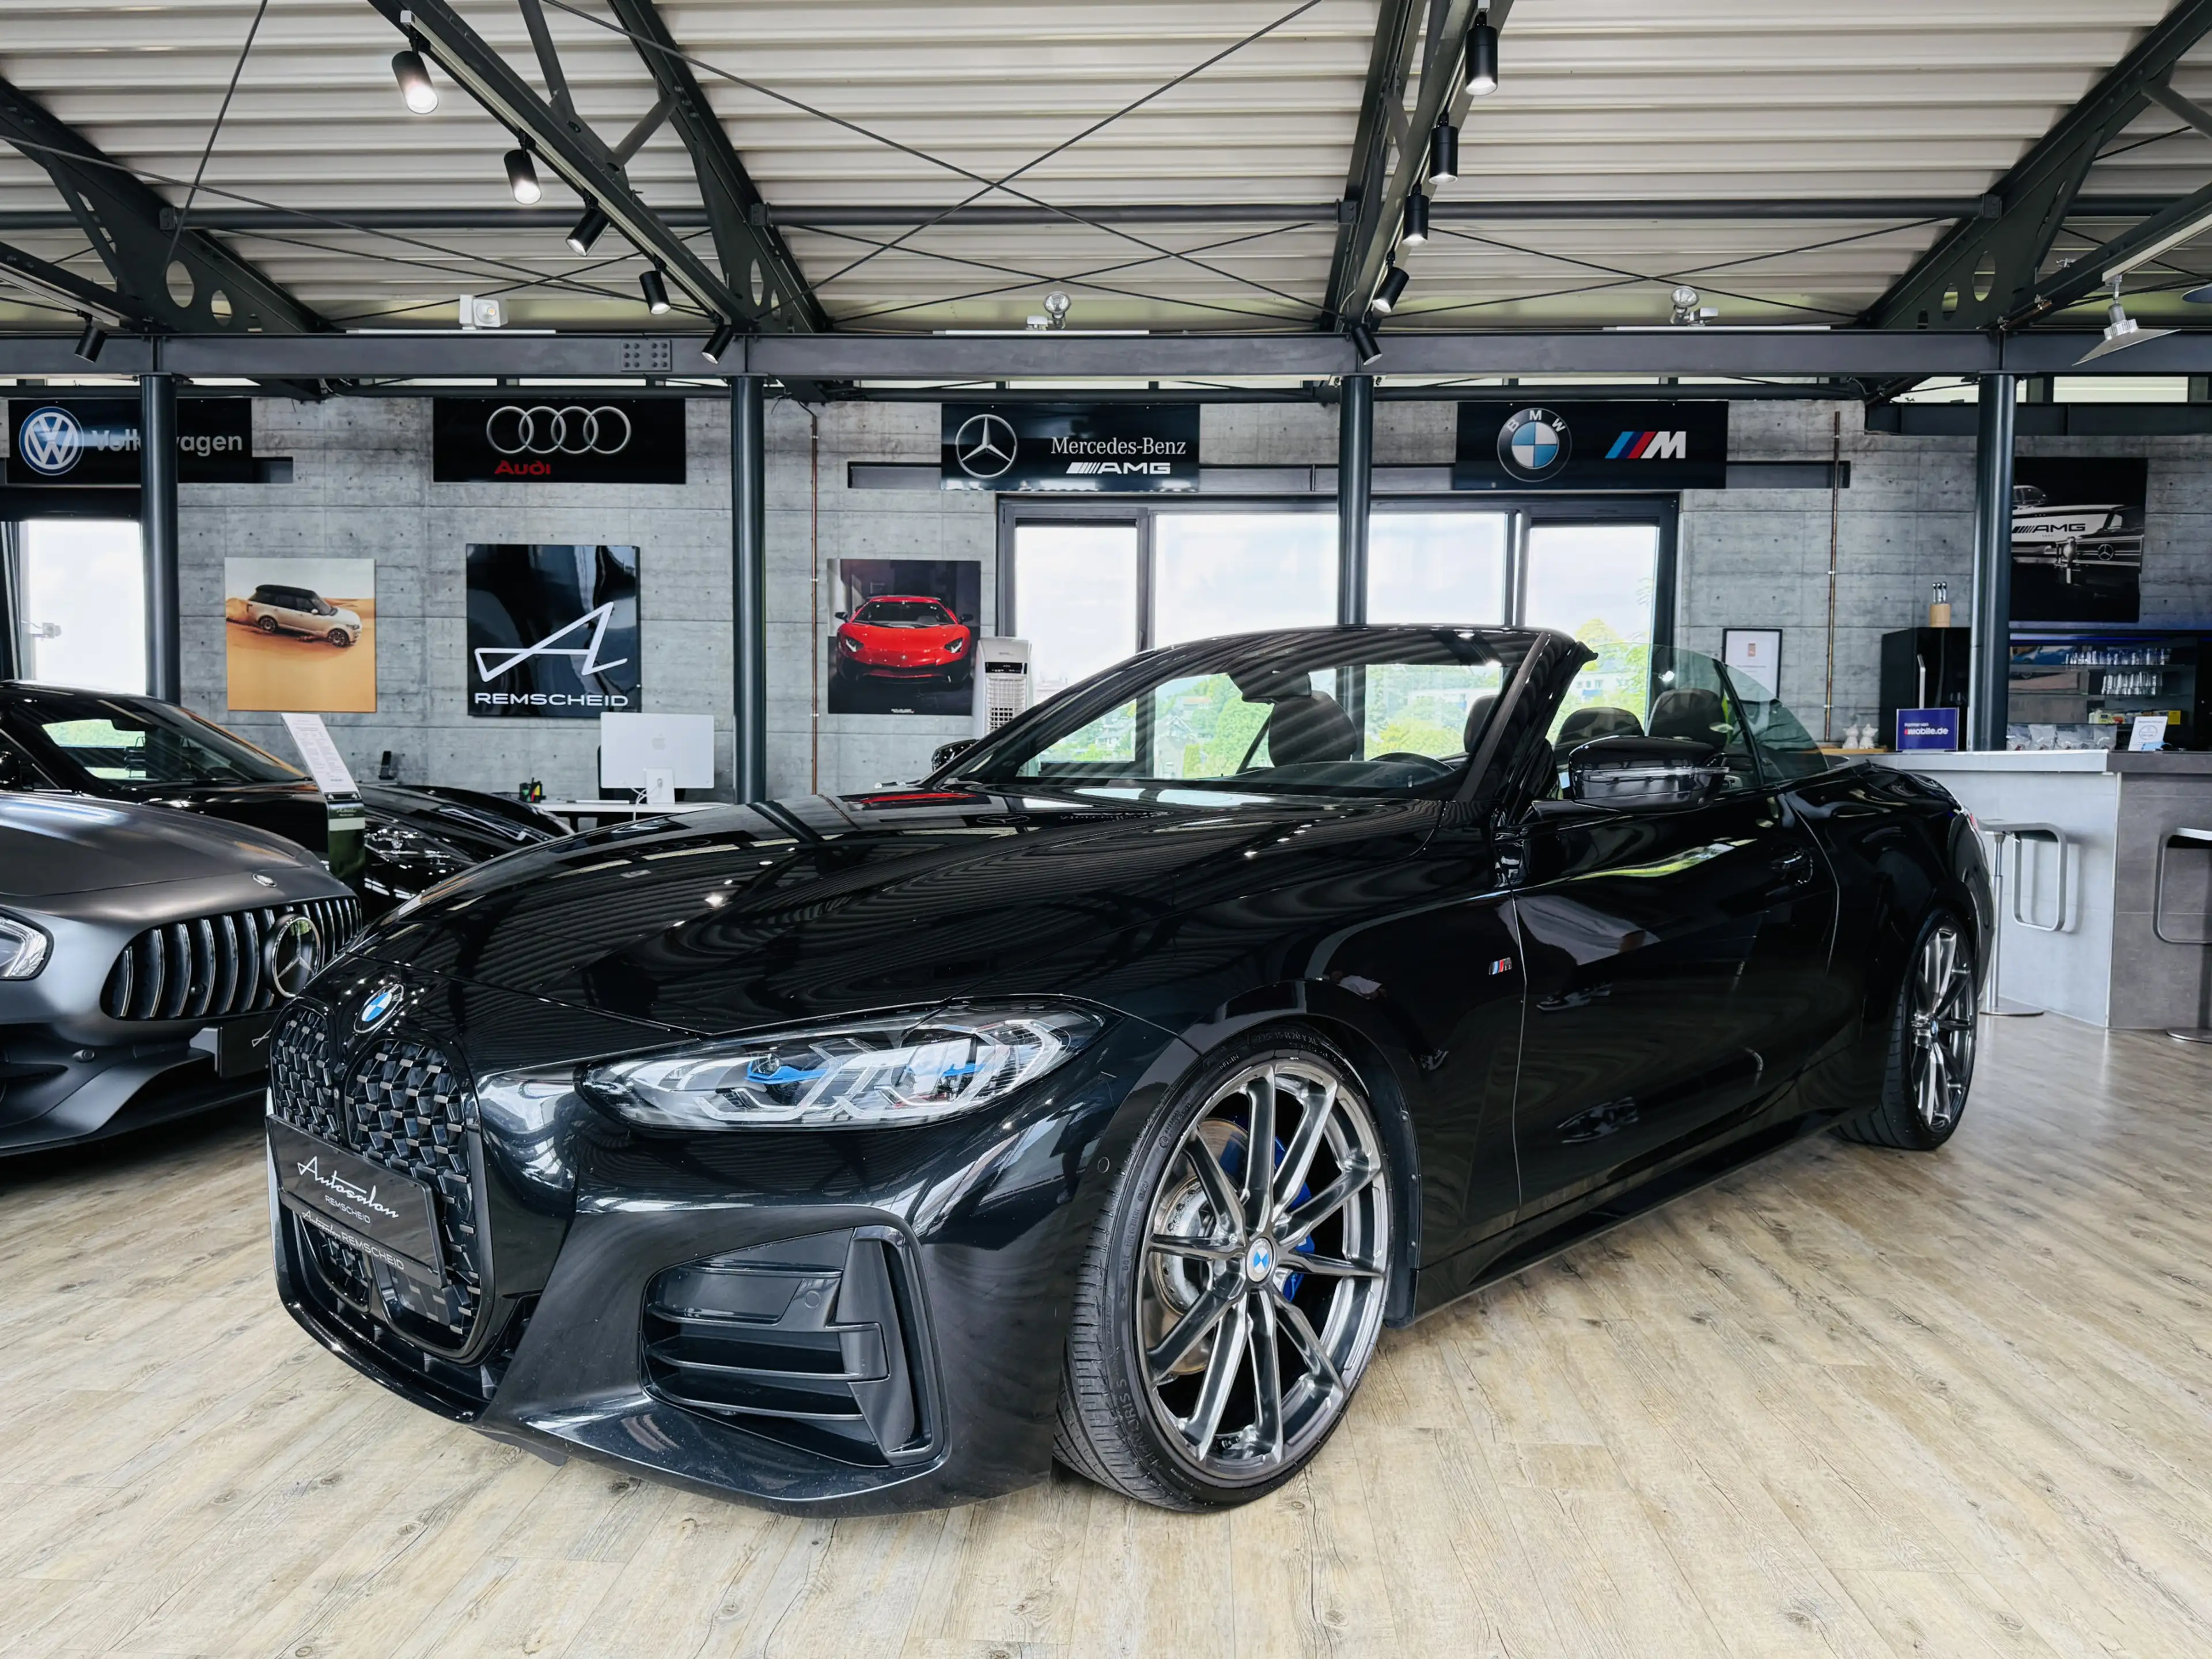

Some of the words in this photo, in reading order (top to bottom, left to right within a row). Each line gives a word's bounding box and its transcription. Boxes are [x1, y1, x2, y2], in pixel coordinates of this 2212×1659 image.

[1051, 437, 1186, 454] Mercedes-Benz
[494, 460, 551, 475] Audi
[1097, 462, 1171, 475] AMG
[2032, 523, 2086, 533] AMG
[474, 692, 628, 706] REMSCHEID
[1907, 727, 1949, 735] mobile.de
[297, 1156, 399, 1218] Autosalon
[325, 1195, 370, 1224] REMSCHEID
[341, 1232, 404, 1270] REMSCHEID
